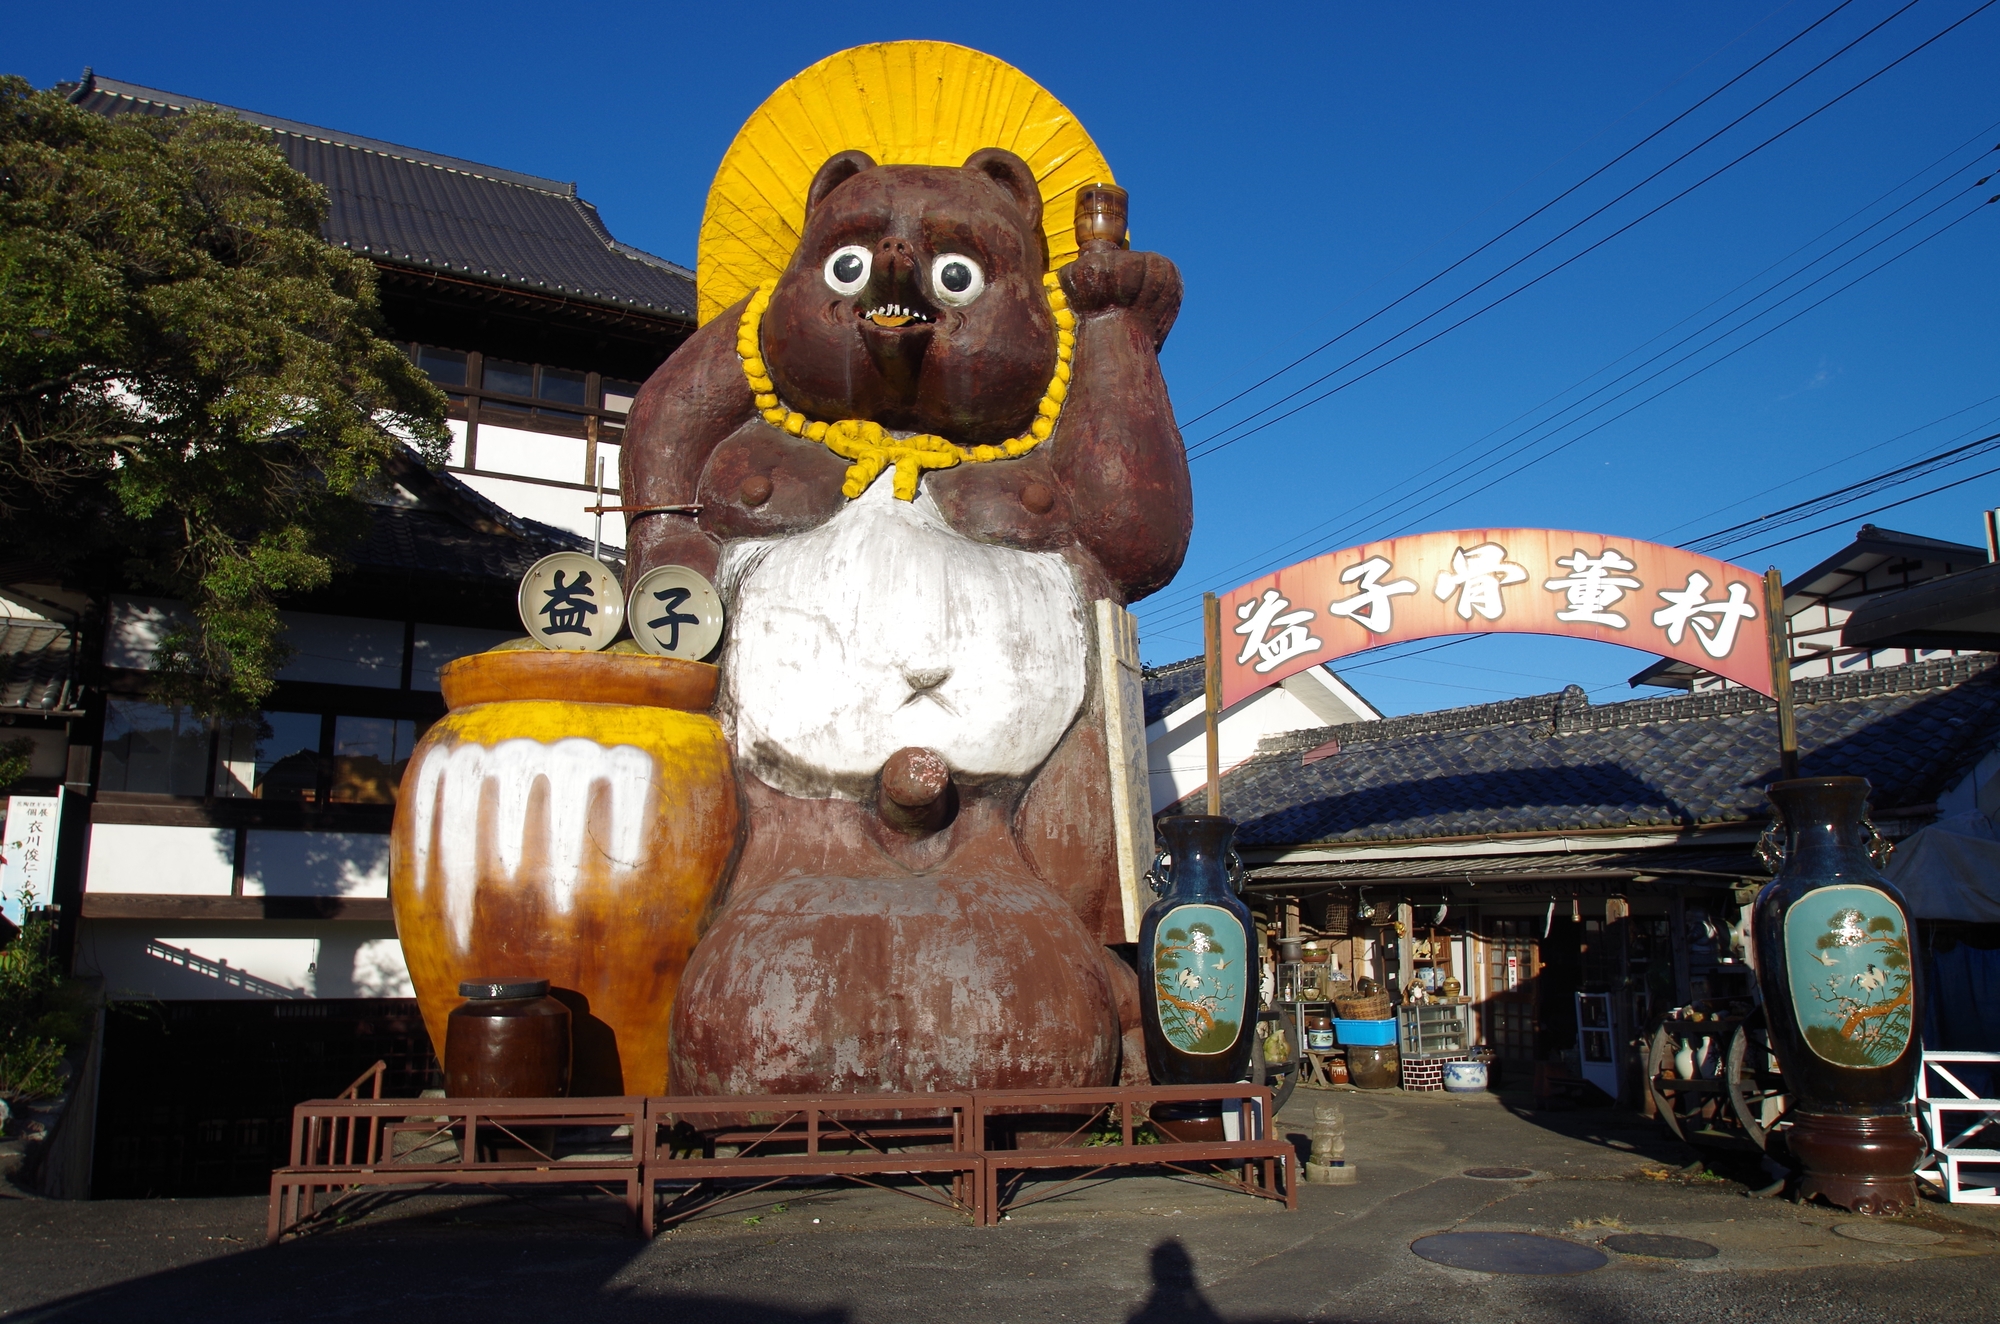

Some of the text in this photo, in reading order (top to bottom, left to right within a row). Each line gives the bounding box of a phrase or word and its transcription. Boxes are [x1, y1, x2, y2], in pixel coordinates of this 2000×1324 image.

[1235, 542, 1757, 674] 益子骨董村
[26, 808, 48, 817] 個展
